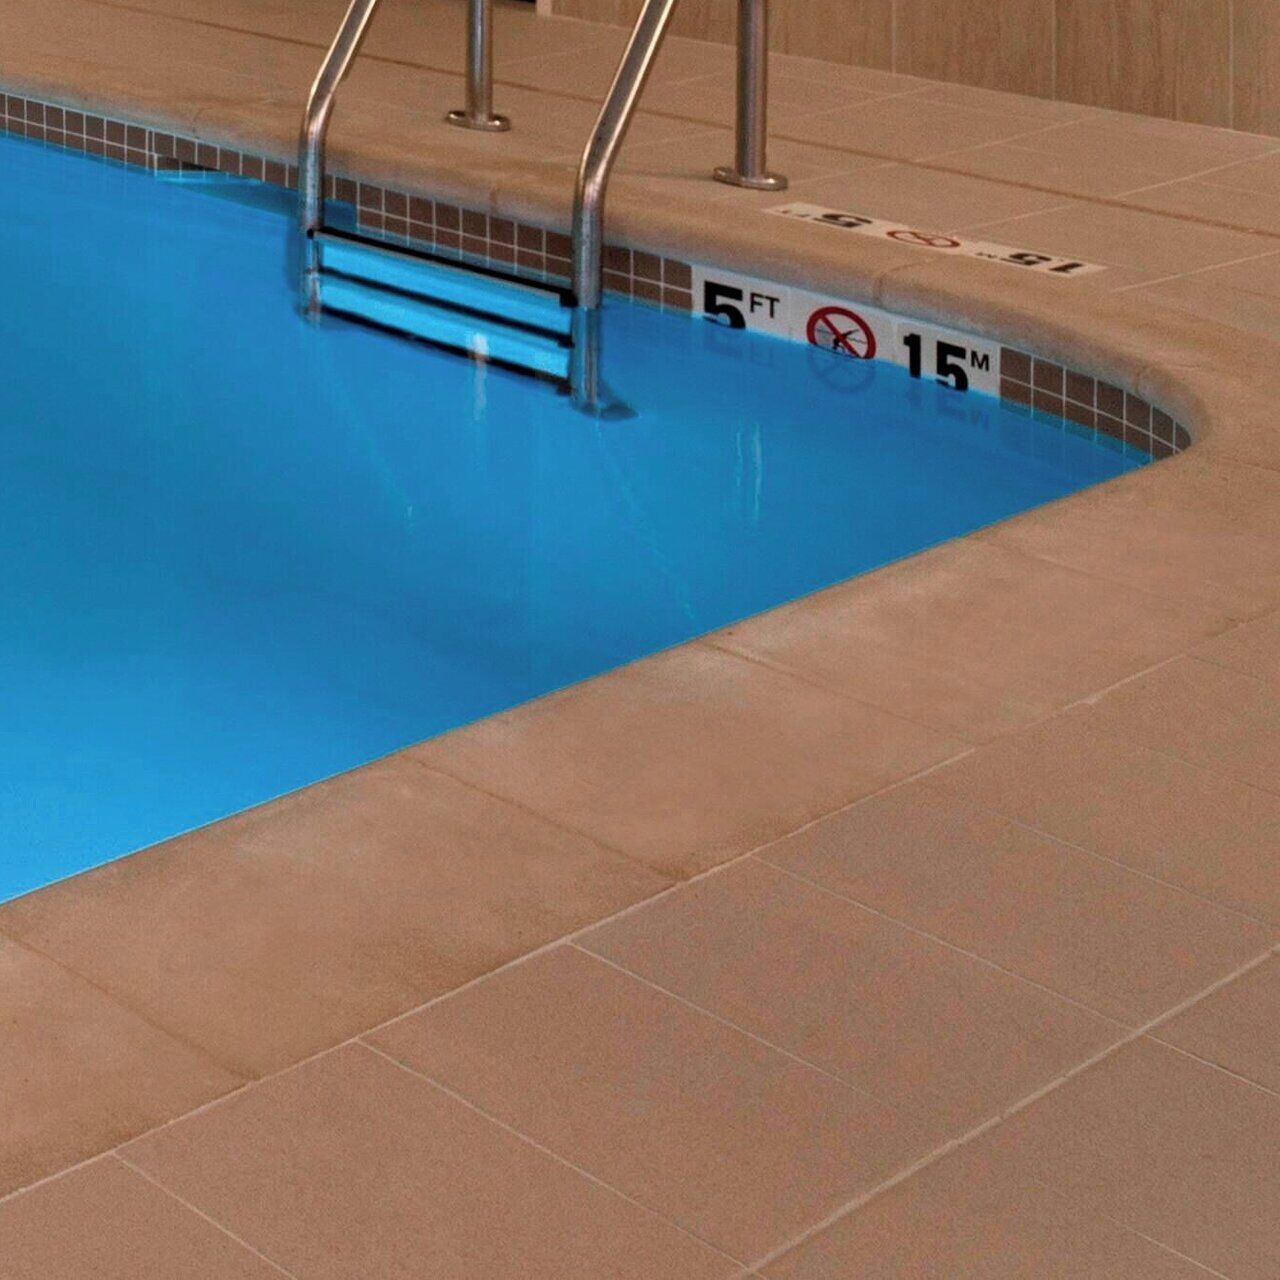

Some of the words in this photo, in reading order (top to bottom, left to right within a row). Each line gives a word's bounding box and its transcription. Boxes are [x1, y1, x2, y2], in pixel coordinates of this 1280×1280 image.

[812, 213, 873, 228] 5
[704, 280, 746, 330] 5
[749, 291, 781, 319] FT
[970, 349, 990, 372] M
